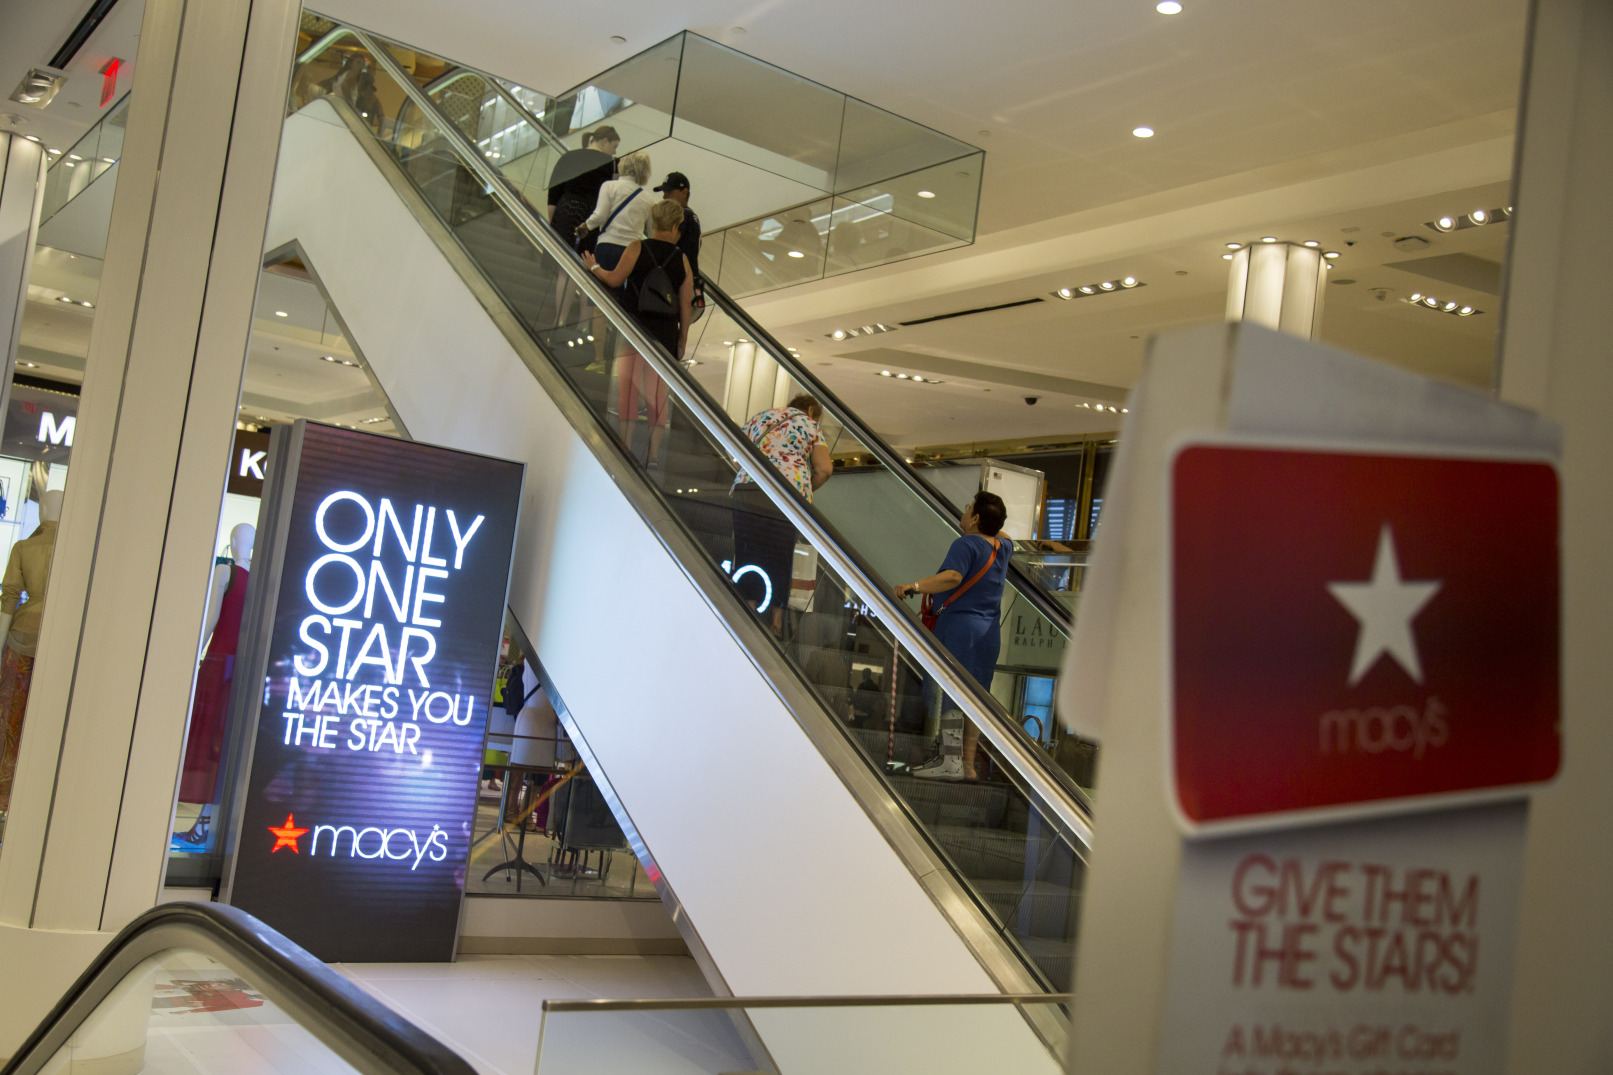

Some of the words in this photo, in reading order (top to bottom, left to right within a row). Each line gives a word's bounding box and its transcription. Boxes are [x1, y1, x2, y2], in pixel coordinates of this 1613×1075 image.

[315, 490, 485, 570] ONLY
[305, 553, 449, 628] ONE
[294, 614, 437, 688] STAR
[1014, 636, 1053, 649] RALPH
[282, 712, 341, 749] THE
[347, 718, 421, 755] STAR
[286, 677, 400, 720] MAKES
[407, 689, 475, 726] YOU
[1319, 695, 1449, 760] macy's
[310, 823, 449, 871] macy's
[1231, 853, 1352, 922] GIVE
[1360, 862, 1480, 929] THEM
[1227, 919, 1319, 990] THE
[1329, 924, 1479, 996] STARS!
[1220, 1022, 1246, 1057] A
[1251, 1022, 1343, 1068] Macy's
[1346, 1022, 1391, 1061] Gift
[1395, 1022, 1461, 1061] Card
